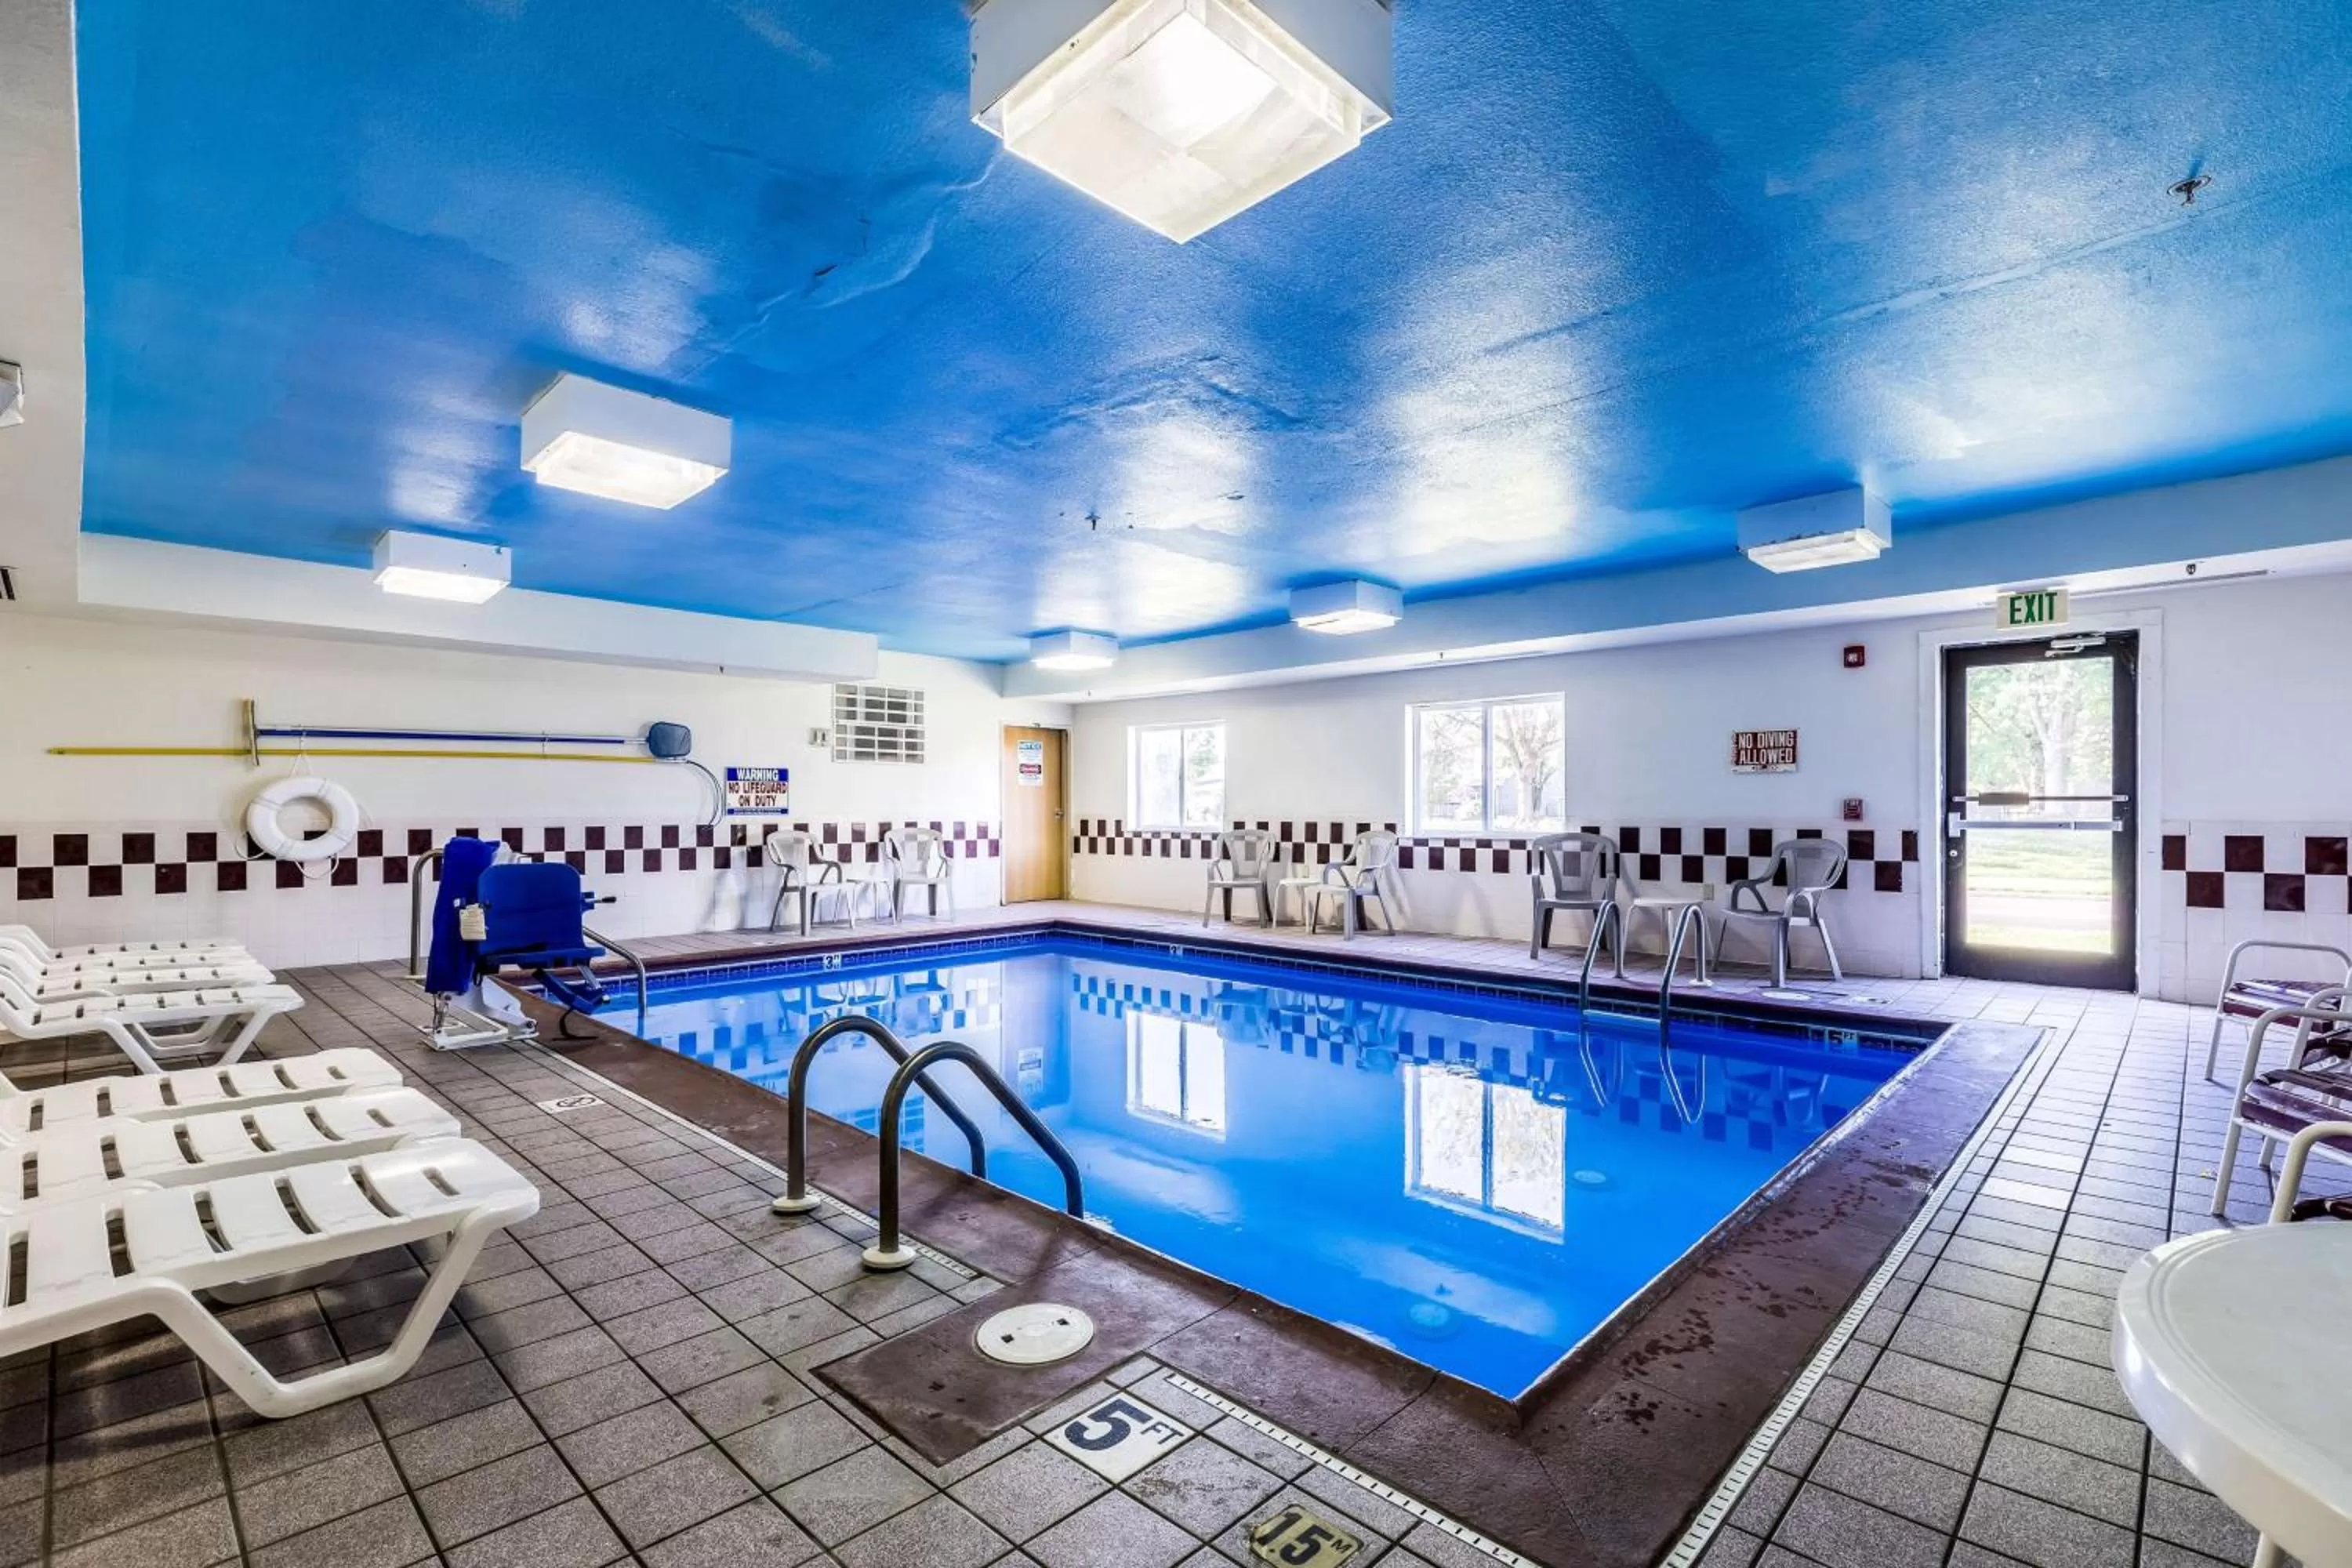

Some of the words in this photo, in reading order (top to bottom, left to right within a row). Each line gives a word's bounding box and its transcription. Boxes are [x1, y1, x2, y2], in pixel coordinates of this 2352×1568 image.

[2009, 592, 2058, 625] EXIT
[1738, 733, 1753, 750] NO
[1757, 731, 1795, 748] DIVING
[1740, 748, 1794, 764] ALLOWED
[736, 769, 779, 781] WARNING
[728, 782, 739, 793] NO
[739, 795, 750, 806] ON
[755, 795, 777, 806] DUTY
[1064, 1399, 1153, 1450] 5
[1141, 1421, 1185, 1444] FT
[1330, 1538, 1353, 1554] M
